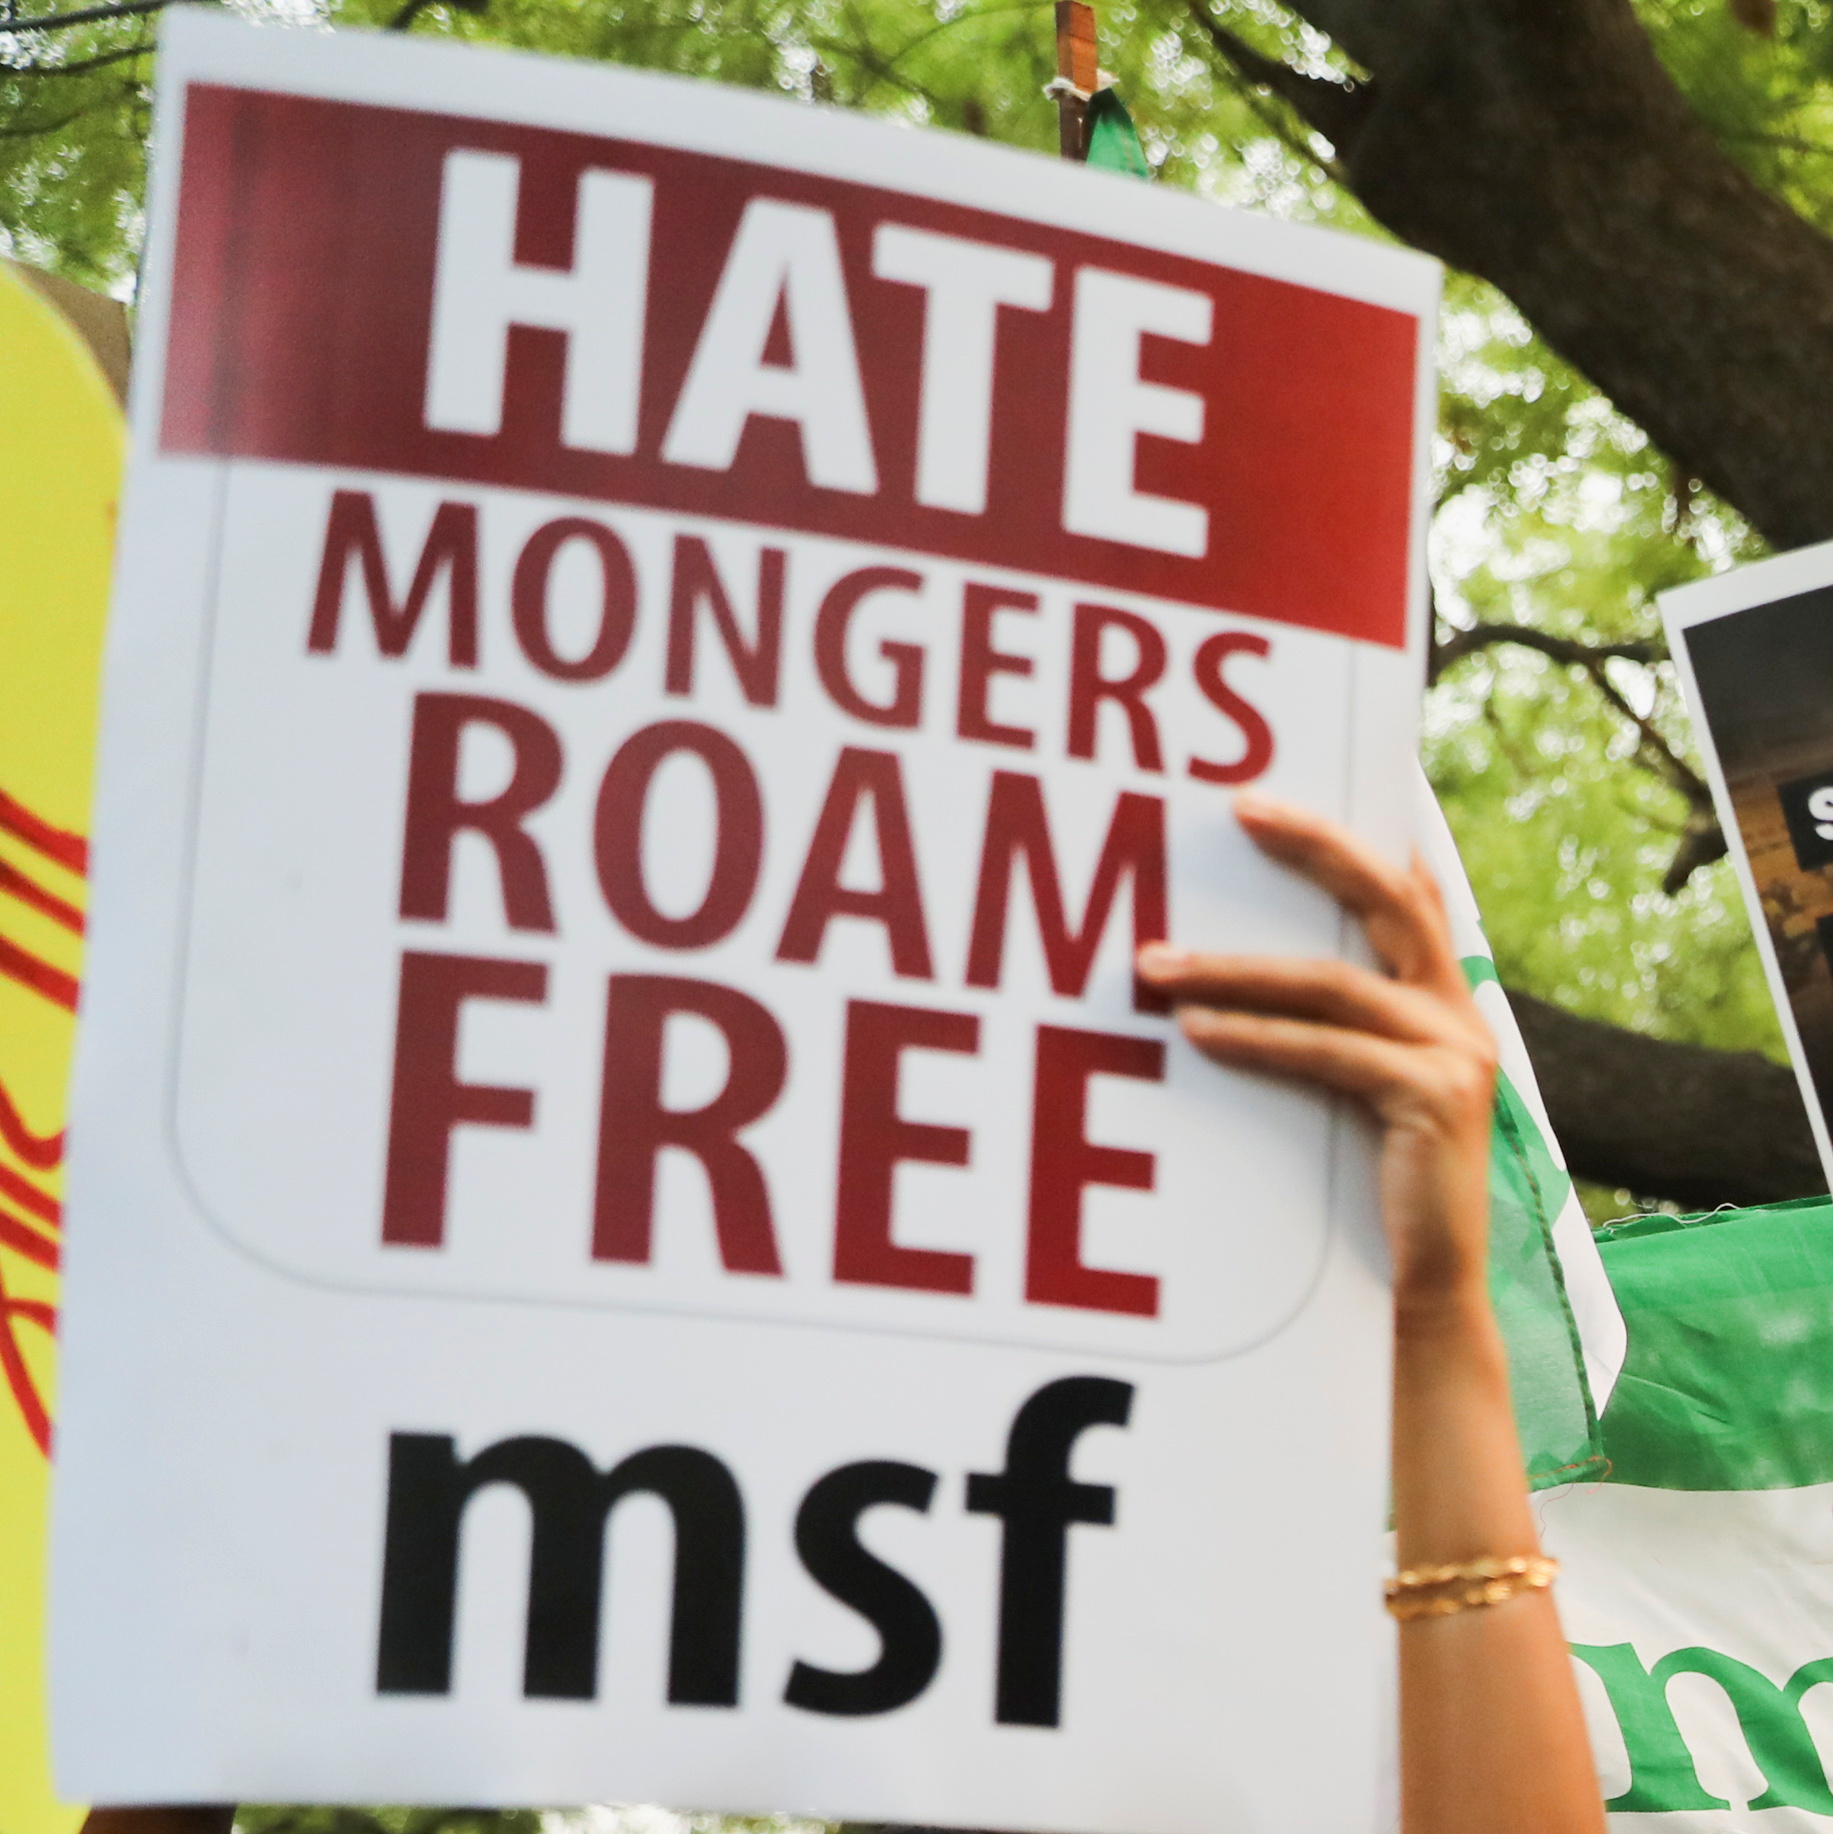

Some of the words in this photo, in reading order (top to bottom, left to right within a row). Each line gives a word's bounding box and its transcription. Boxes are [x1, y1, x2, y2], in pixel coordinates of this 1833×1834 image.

[422, 147, 1215, 558] HATE
[306, 488, 1276, 785] MONGERS
[399, 690, 1176, 1014] ROAM
[381, 950, 1170, 1320] FREE
[375, 1374, 1137, 1729] msf
